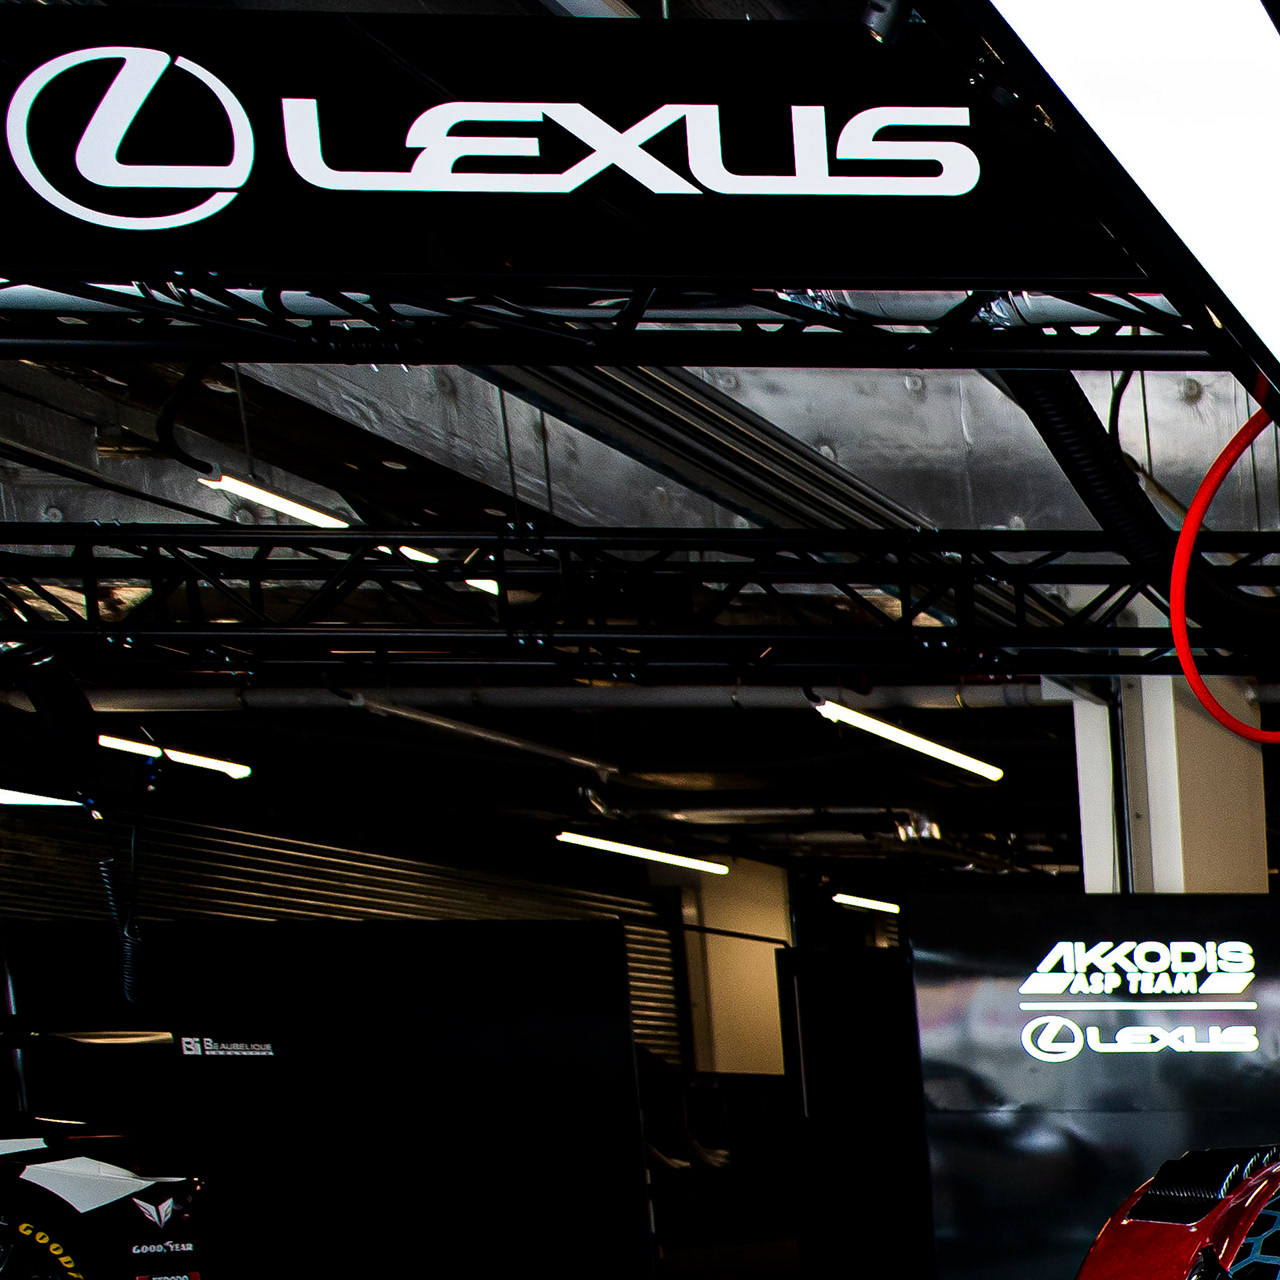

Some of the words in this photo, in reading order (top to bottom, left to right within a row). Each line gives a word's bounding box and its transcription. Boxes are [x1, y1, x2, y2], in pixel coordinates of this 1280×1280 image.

[281, 98, 980, 195] LEXUS
[1069, 972, 1122, 994] ASP
[1126, 972, 1198, 994] TEAM
[1085, 1026, 1259, 1053] LEXUS
